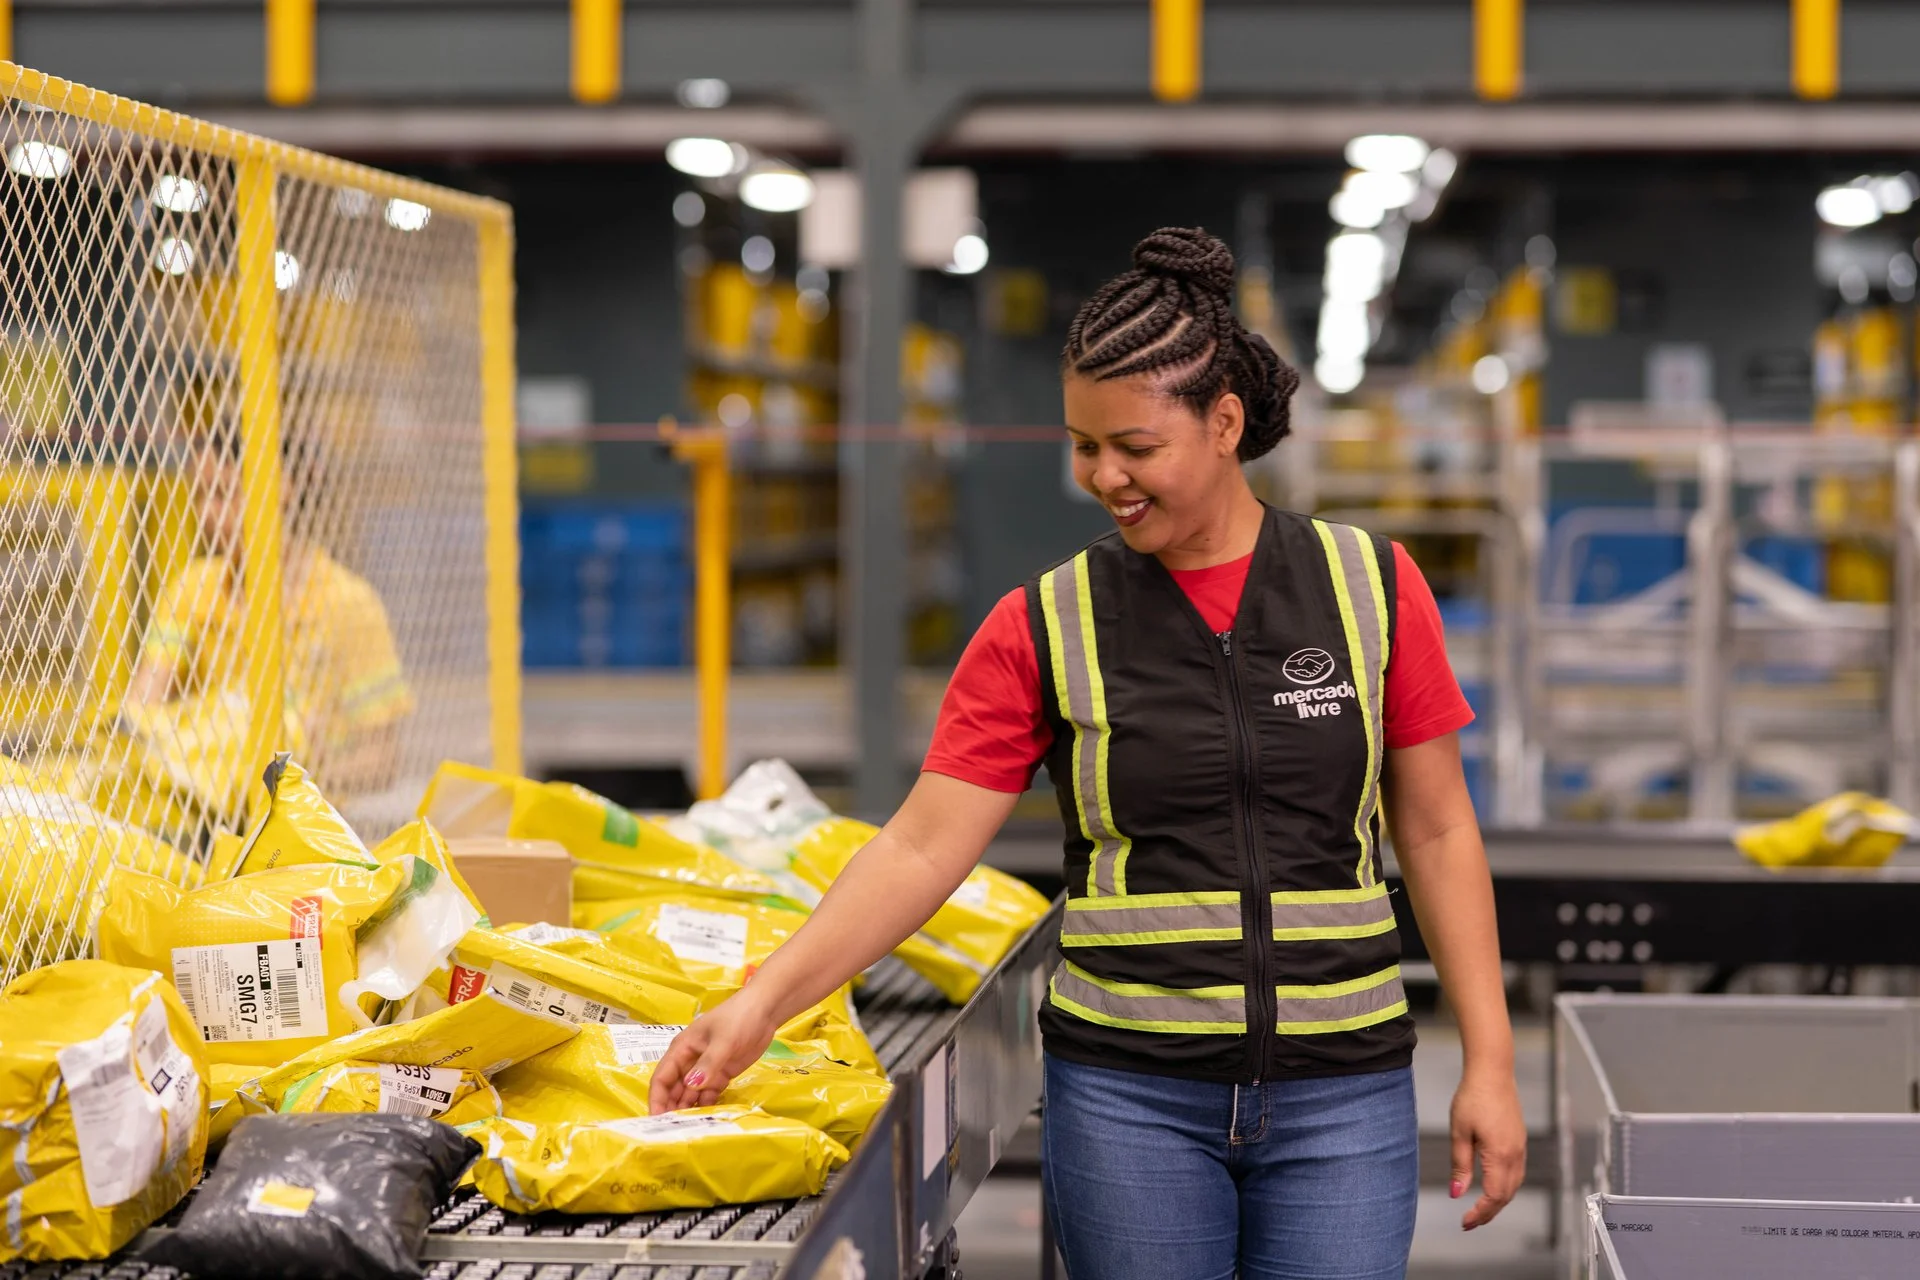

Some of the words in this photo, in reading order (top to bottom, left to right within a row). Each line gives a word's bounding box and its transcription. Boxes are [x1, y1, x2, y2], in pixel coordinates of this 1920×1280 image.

[1273, 681, 1356, 706] mercado
[1296, 701, 1342, 719] livre
[258, 953, 271, 982] FBA01
[236, 974, 258, 1024] SMG7
[425, 1088, 446, 1102] FBA01
[1763, 1227, 1787, 1236] LIMITE
[1790, 1227, 1799, 1236] DE
[1802, 1228, 1823, 1236] CARGA
[1825, 1228, 1838, 1237] NAO
[1841, 1229, 1870, 1238] COLOCAR
[1872, 1230, 1904, 1239] MATERIAL
